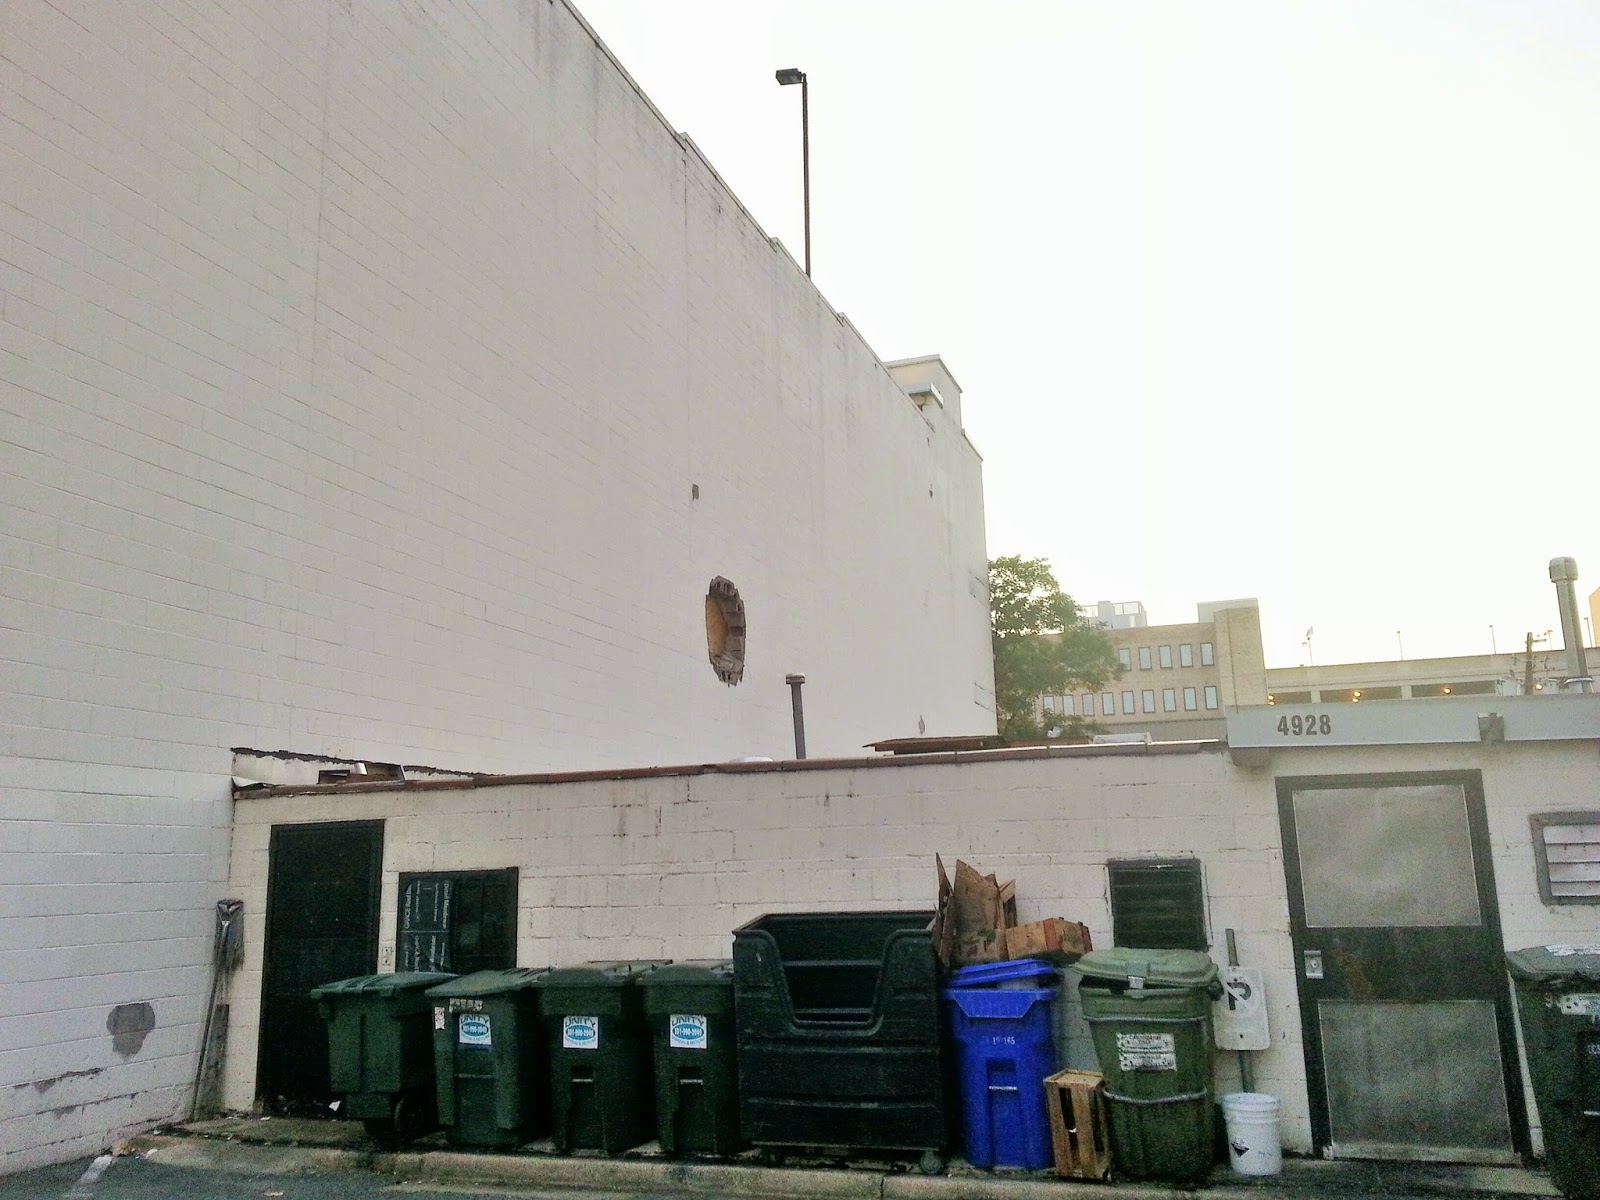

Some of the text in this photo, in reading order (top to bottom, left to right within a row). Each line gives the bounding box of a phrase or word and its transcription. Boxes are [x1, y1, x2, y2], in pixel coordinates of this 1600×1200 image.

[1277, 714, 1331, 736] 4928
[460, 1014, 489, 1025] UNITY
[565, 1015, 596, 1028] UNITY
[672, 1015, 704, 1027] UNITY
